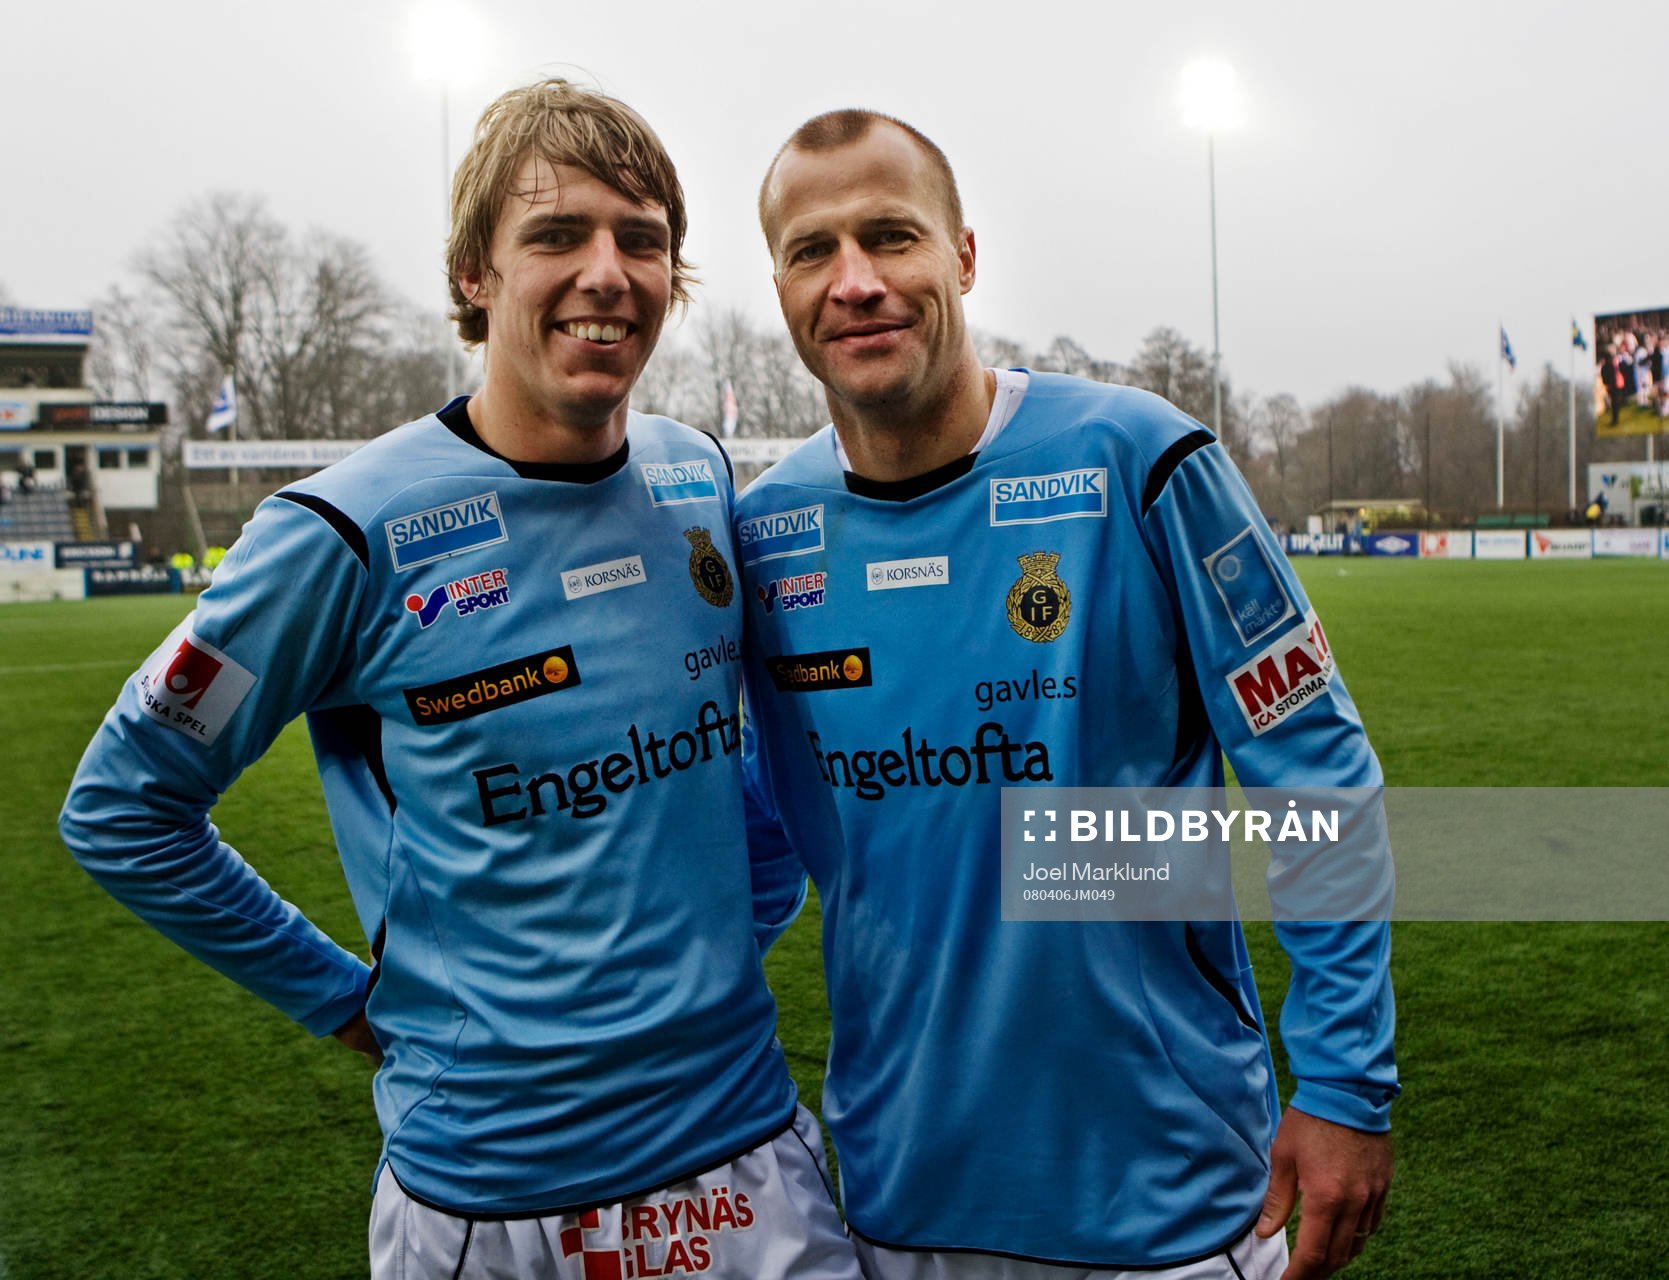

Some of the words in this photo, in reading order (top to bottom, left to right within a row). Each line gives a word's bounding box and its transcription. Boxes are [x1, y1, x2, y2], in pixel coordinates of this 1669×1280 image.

[647, 464, 711, 485] SANDVIK
[995, 472, 1101, 503] SANDVIK
[391, 498, 495, 546] SANDVIK
[740, 509, 820, 545] SANDVIK
[585, 562, 641, 588] KORSNÄS
[779, 573, 823, 595] INTER
[886, 562, 944, 581] KORSNÄS
[448, 569, 506, 600] INTER
[455, 586, 509, 616] SPORT
[782, 589, 825, 611] SPORT
[1032, 590, 1047, 605] G
[416, 667, 542, 717] Swedbank
[173, 711, 206, 736] SPEL
[1253, 711, 1277, 730] ICA
